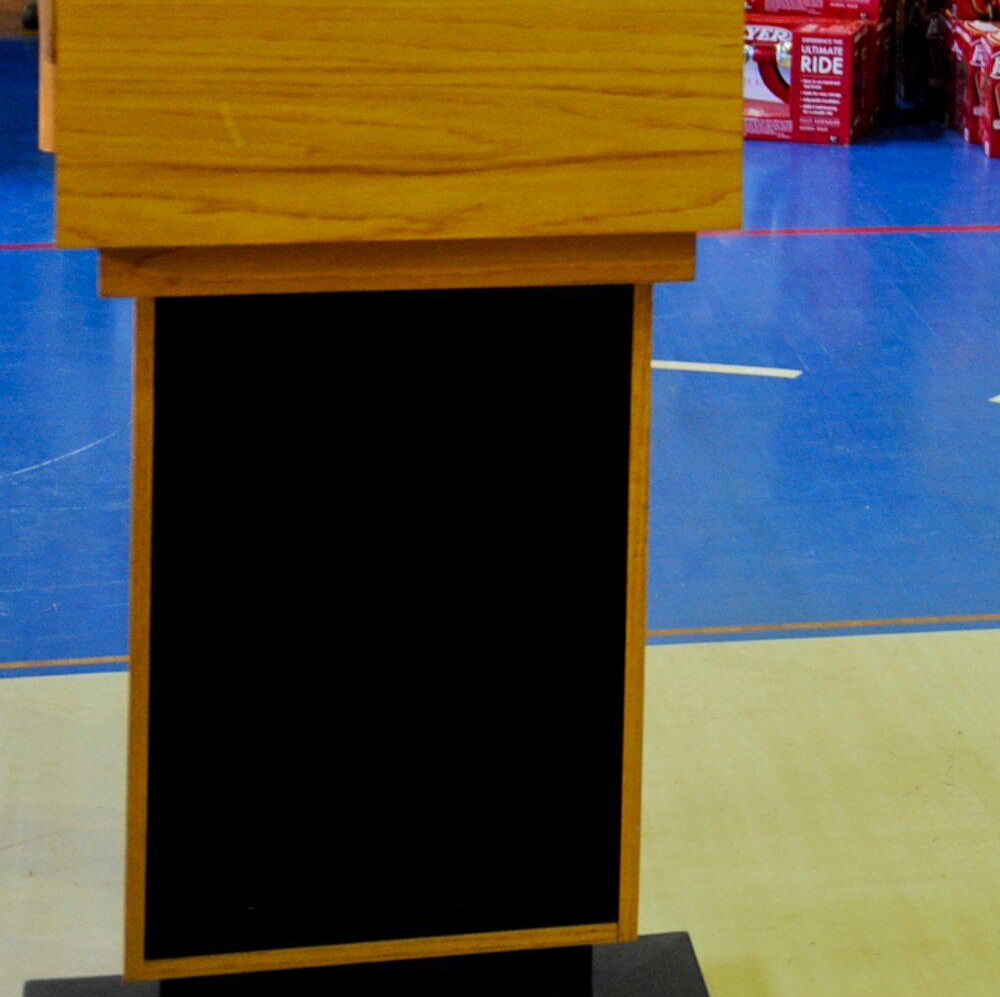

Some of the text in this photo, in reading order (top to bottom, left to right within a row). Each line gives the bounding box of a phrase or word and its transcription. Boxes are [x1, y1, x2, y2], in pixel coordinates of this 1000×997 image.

[745, 25, 792, 41] YER
[801, 45, 843, 56] ULTIMATE
[801, 56, 843, 74] RIDE
